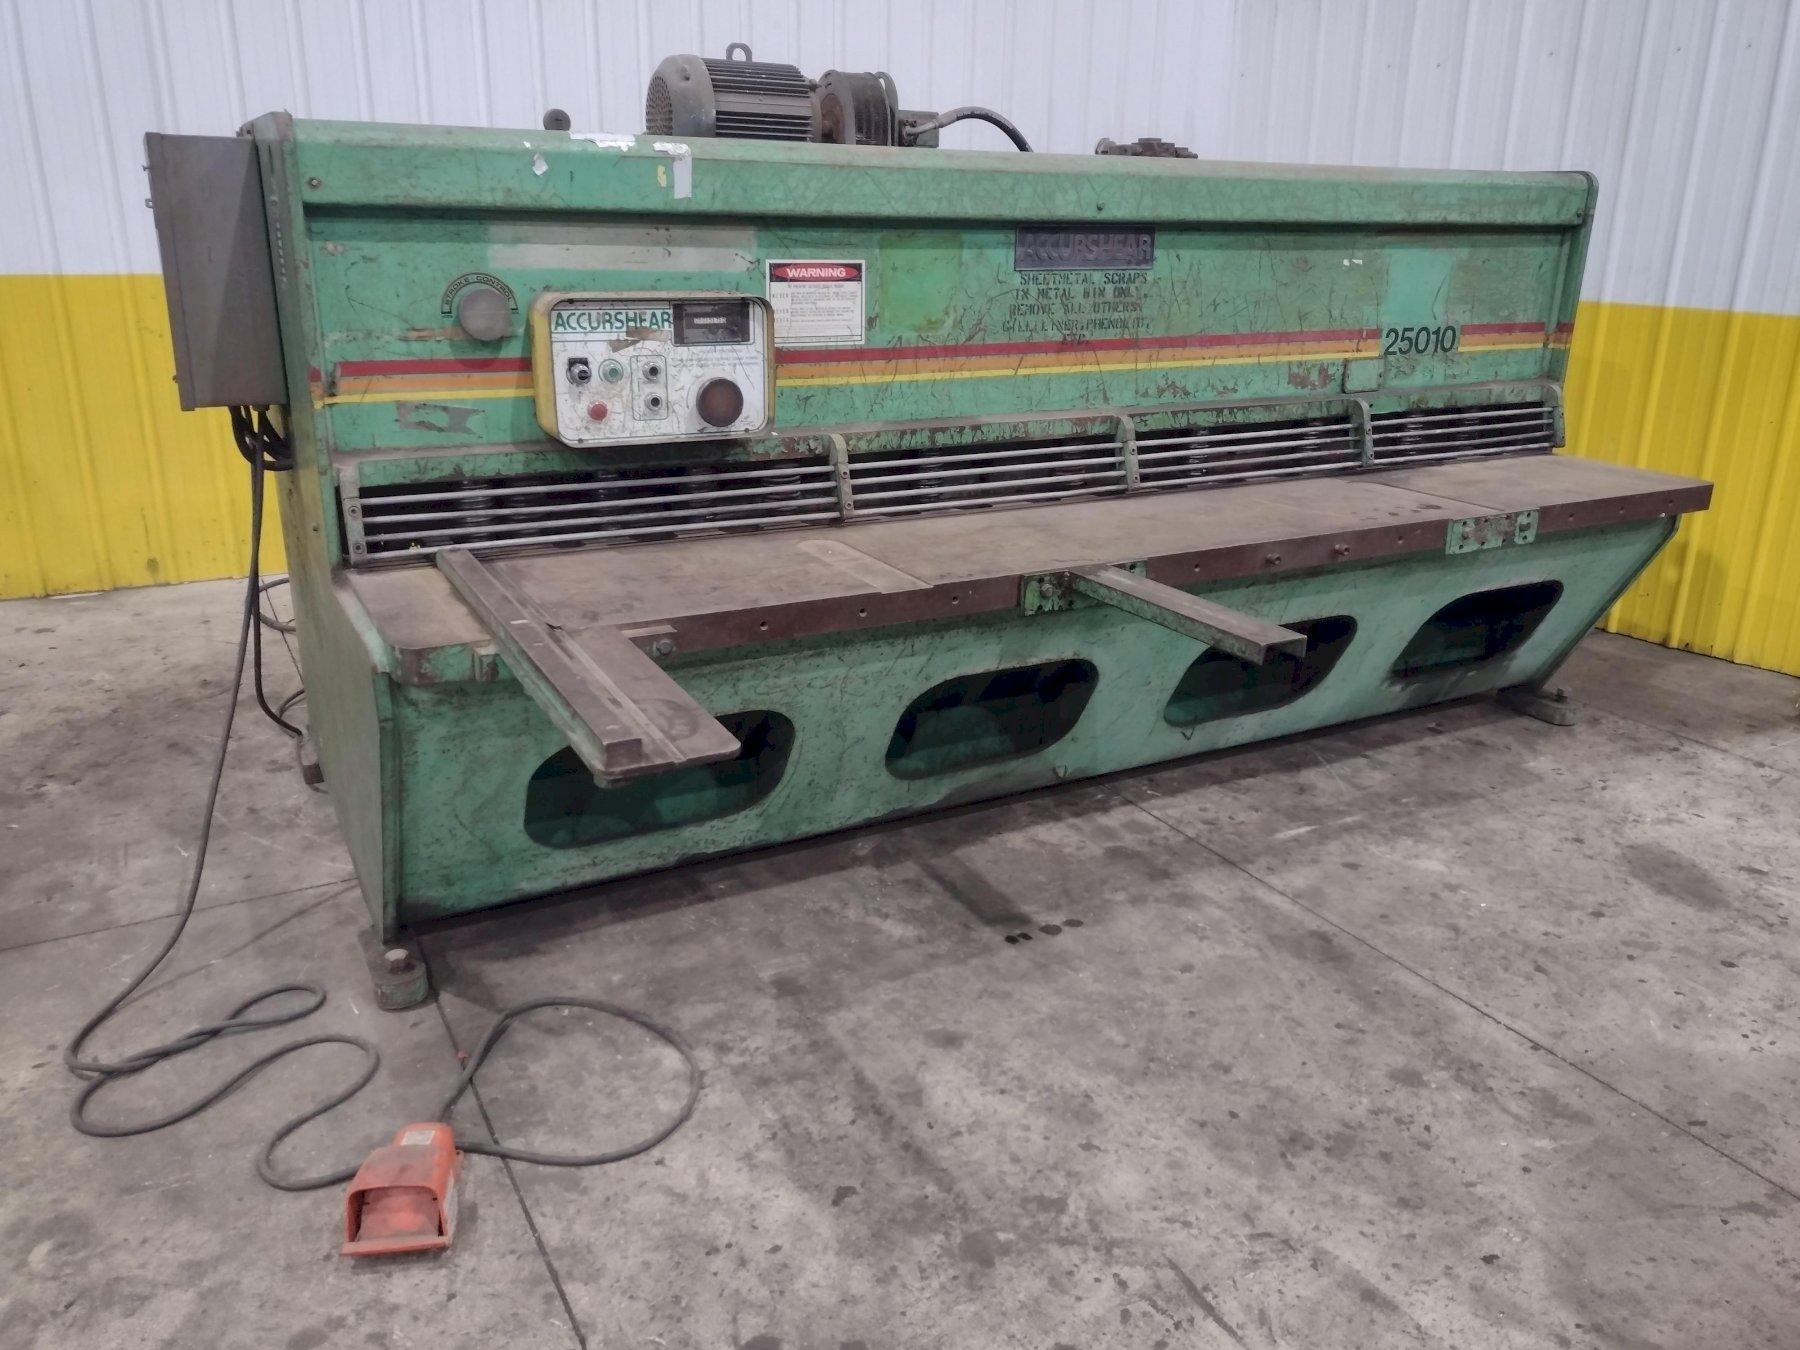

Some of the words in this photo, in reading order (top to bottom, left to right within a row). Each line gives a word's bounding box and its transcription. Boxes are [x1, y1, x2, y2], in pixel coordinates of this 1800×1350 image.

[786, 267, 846, 278] WARNING
[1103, 272, 1148, 285] SCRAPS
[475, 275, 512, 303] CONTROL
[1037, 287, 1075, 301] METAL
[554, 311, 672, 331] ACCURSHEAR
[1383, 325, 1457, 356] 25010
